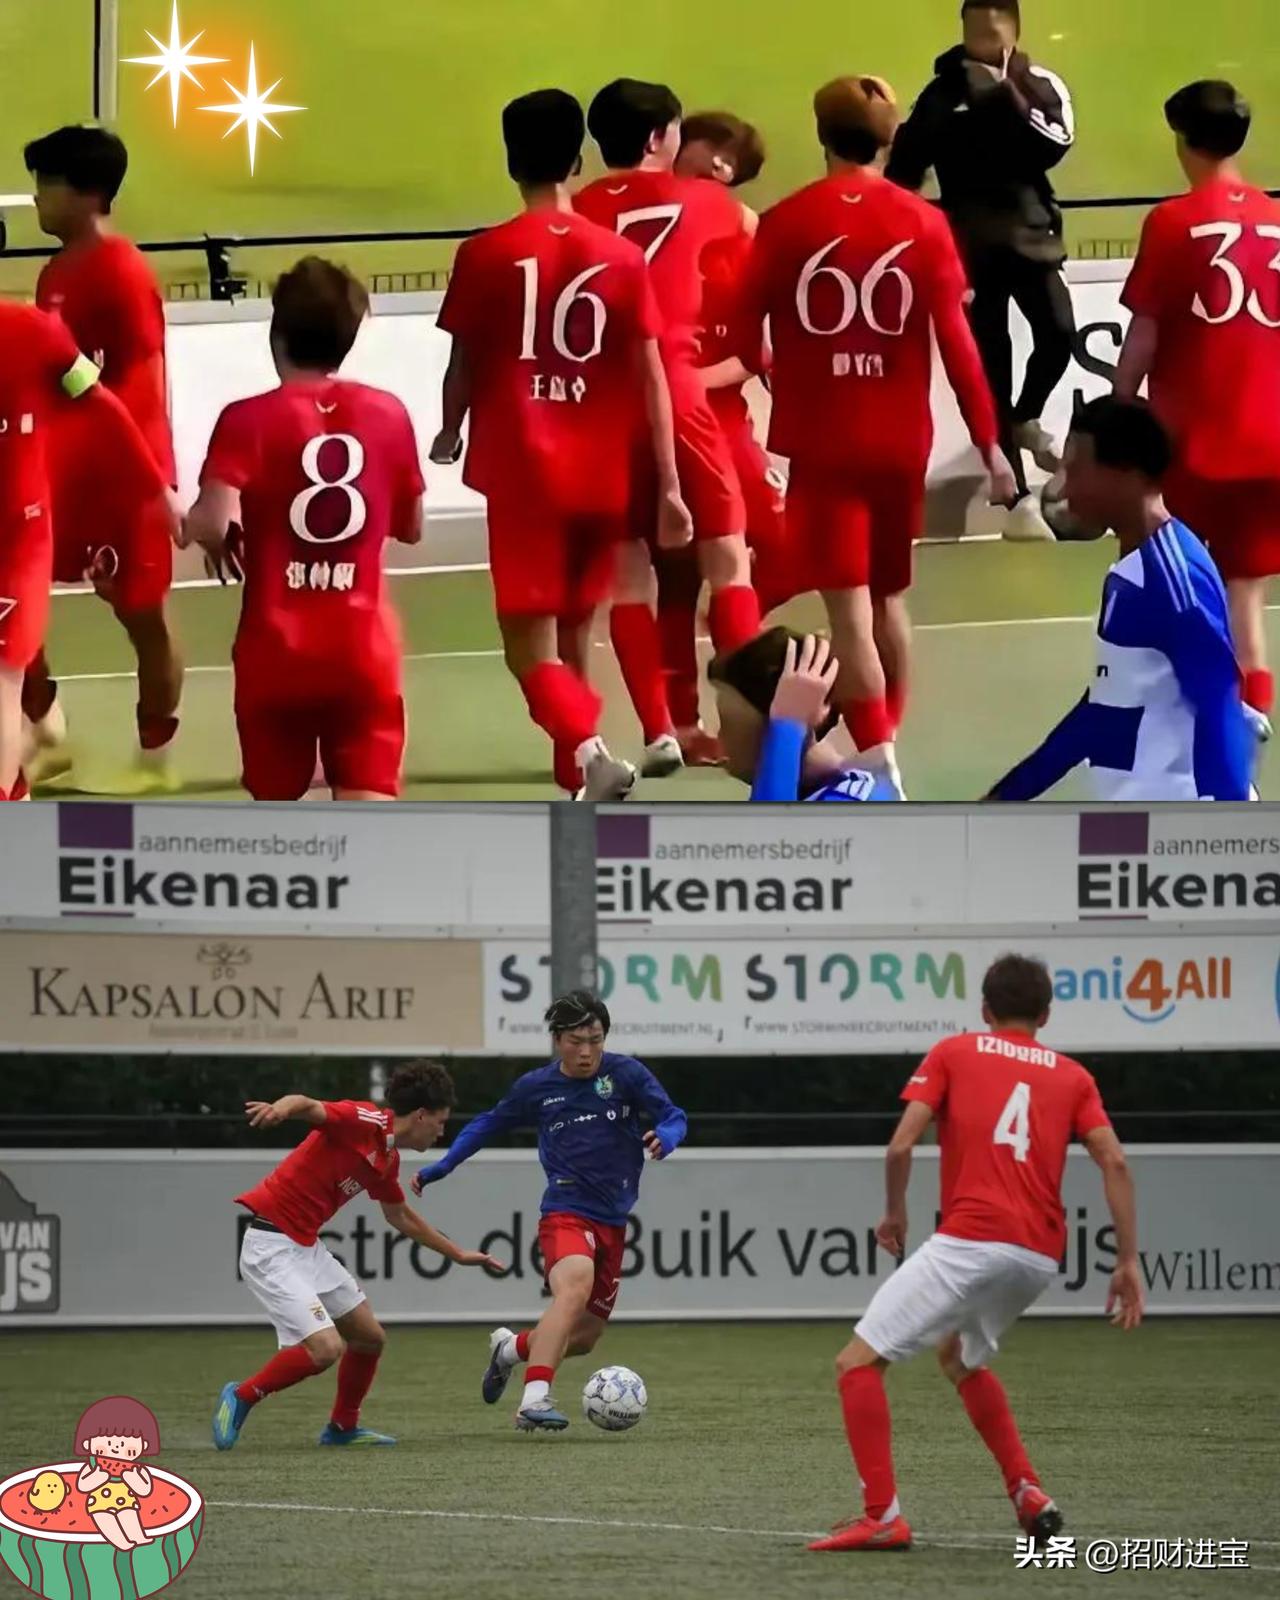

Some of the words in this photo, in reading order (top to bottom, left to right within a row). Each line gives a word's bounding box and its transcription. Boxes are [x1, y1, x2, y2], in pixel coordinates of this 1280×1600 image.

[616, 203, 683, 265] 7
[514, 257, 609, 363] 16
[795, 235, 914, 336] 66
[289, 433, 367, 544] 8
[138, 833, 349, 862] aannemersbedrijf
[655, 836, 853, 864] aannemersbedrijf
[1152, 836, 1280, 856] aannemers
[58, 855, 350, 910] Eikenaar
[745, 953, 967, 1002] STORM
[1053, 955, 1231, 1012] ani4All
[993, 1081, 1031, 1163] 4
